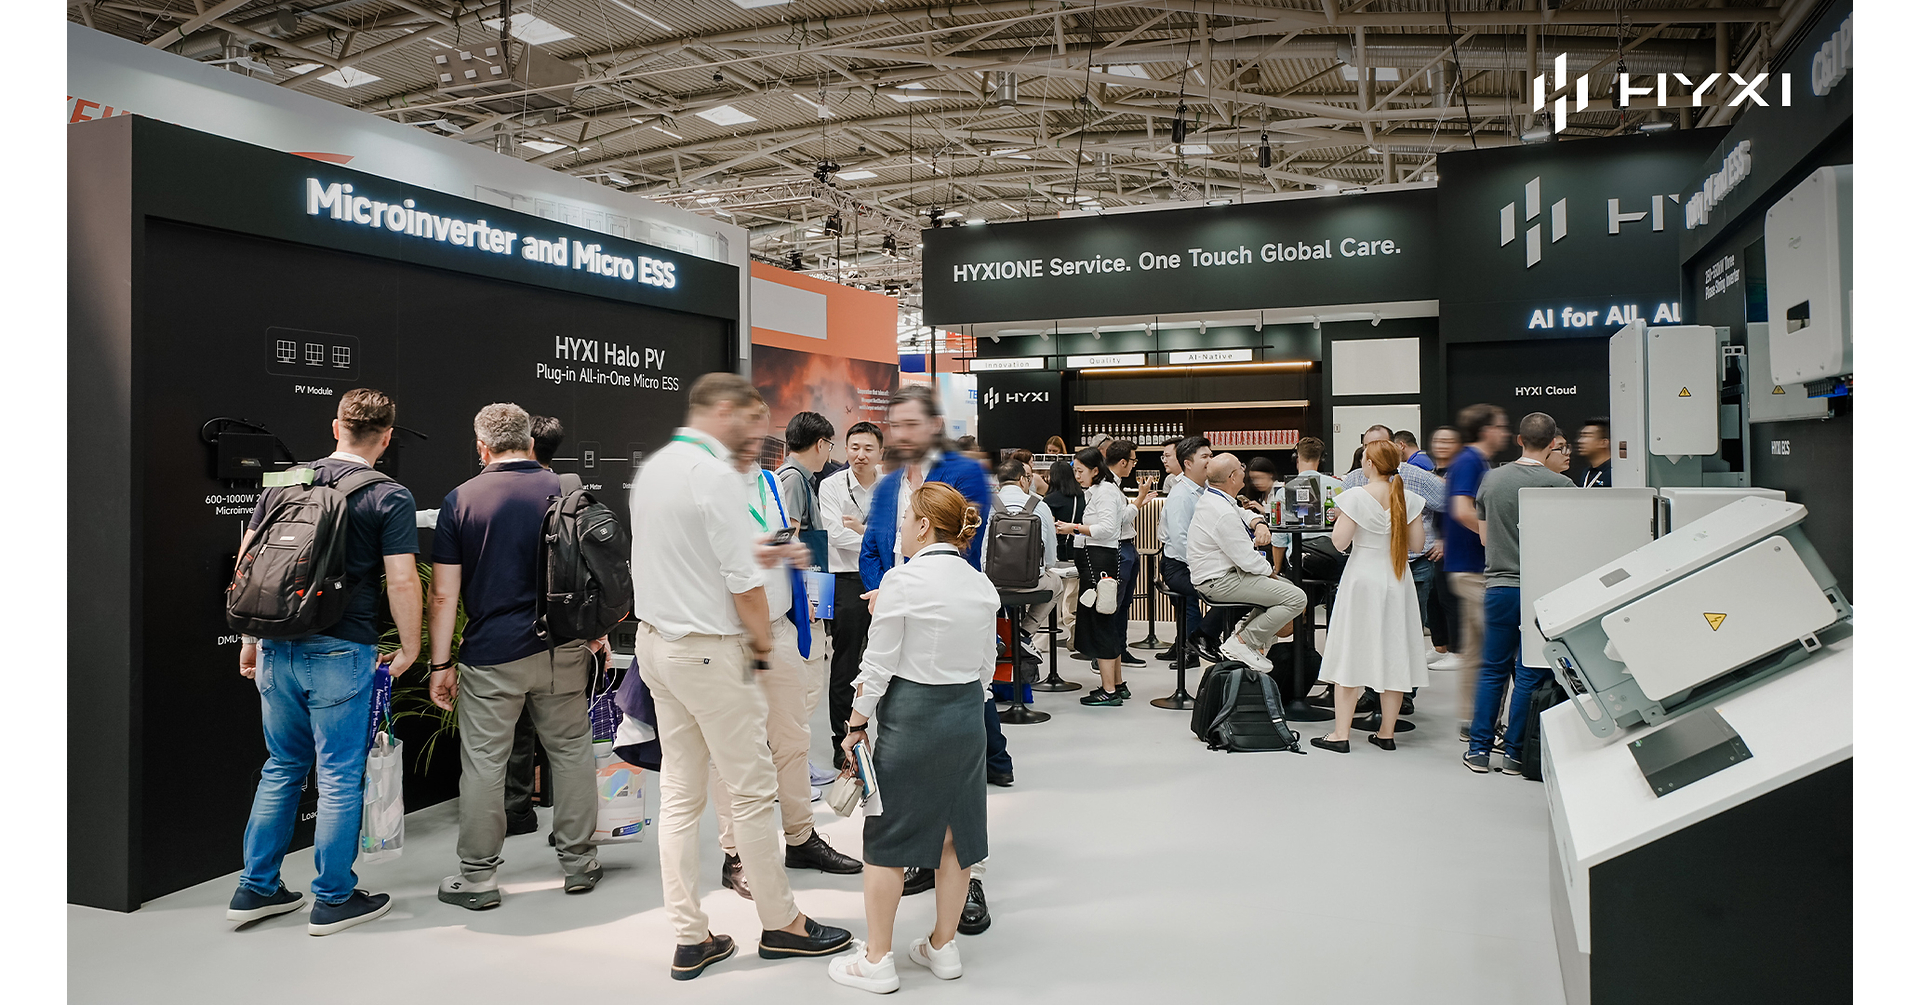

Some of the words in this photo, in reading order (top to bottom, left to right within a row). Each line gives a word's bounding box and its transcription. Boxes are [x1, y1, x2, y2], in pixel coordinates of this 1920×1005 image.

[1608, 194, 1680, 234] H
[306, 176, 517, 255] Microinverter
[521, 234, 568, 267] and
[572, 240, 635, 281] Micro
[638, 255, 677, 289] ESS
[953, 259, 1044, 283] HYXIONE
[1049, 254, 1132, 277] Service.
[1138, 251, 1181, 271] One
[1188, 245, 1253, 267] Touch
[1260, 239, 1333, 263] Global
[1339, 236, 1401, 258] Care.
[1561, 306, 1599, 328] for
[555, 335, 599, 363] HYXI
[604, 340, 640, 368] Halo
[644, 347, 666, 371] PV
[1188, 353, 1234, 361] AI-Native
[1088, 357, 1121, 365] Quality
[536, 363, 576, 386] Plug-in
[578, 366, 631, 388] All-in-One
[632, 371, 660, 389] Micro
[661, 375, 680, 391] ESS
[294, 385, 306, 394] PV
[308, 386, 333, 396] Module
[1006, 391, 1049, 403] HYXI
[1515, 387, 1542, 396] HYXI
[1545, 385, 1577, 396] Cloud
[1771, 440, 1781, 455] HYXI
[217, 634, 243, 646] DMU-
